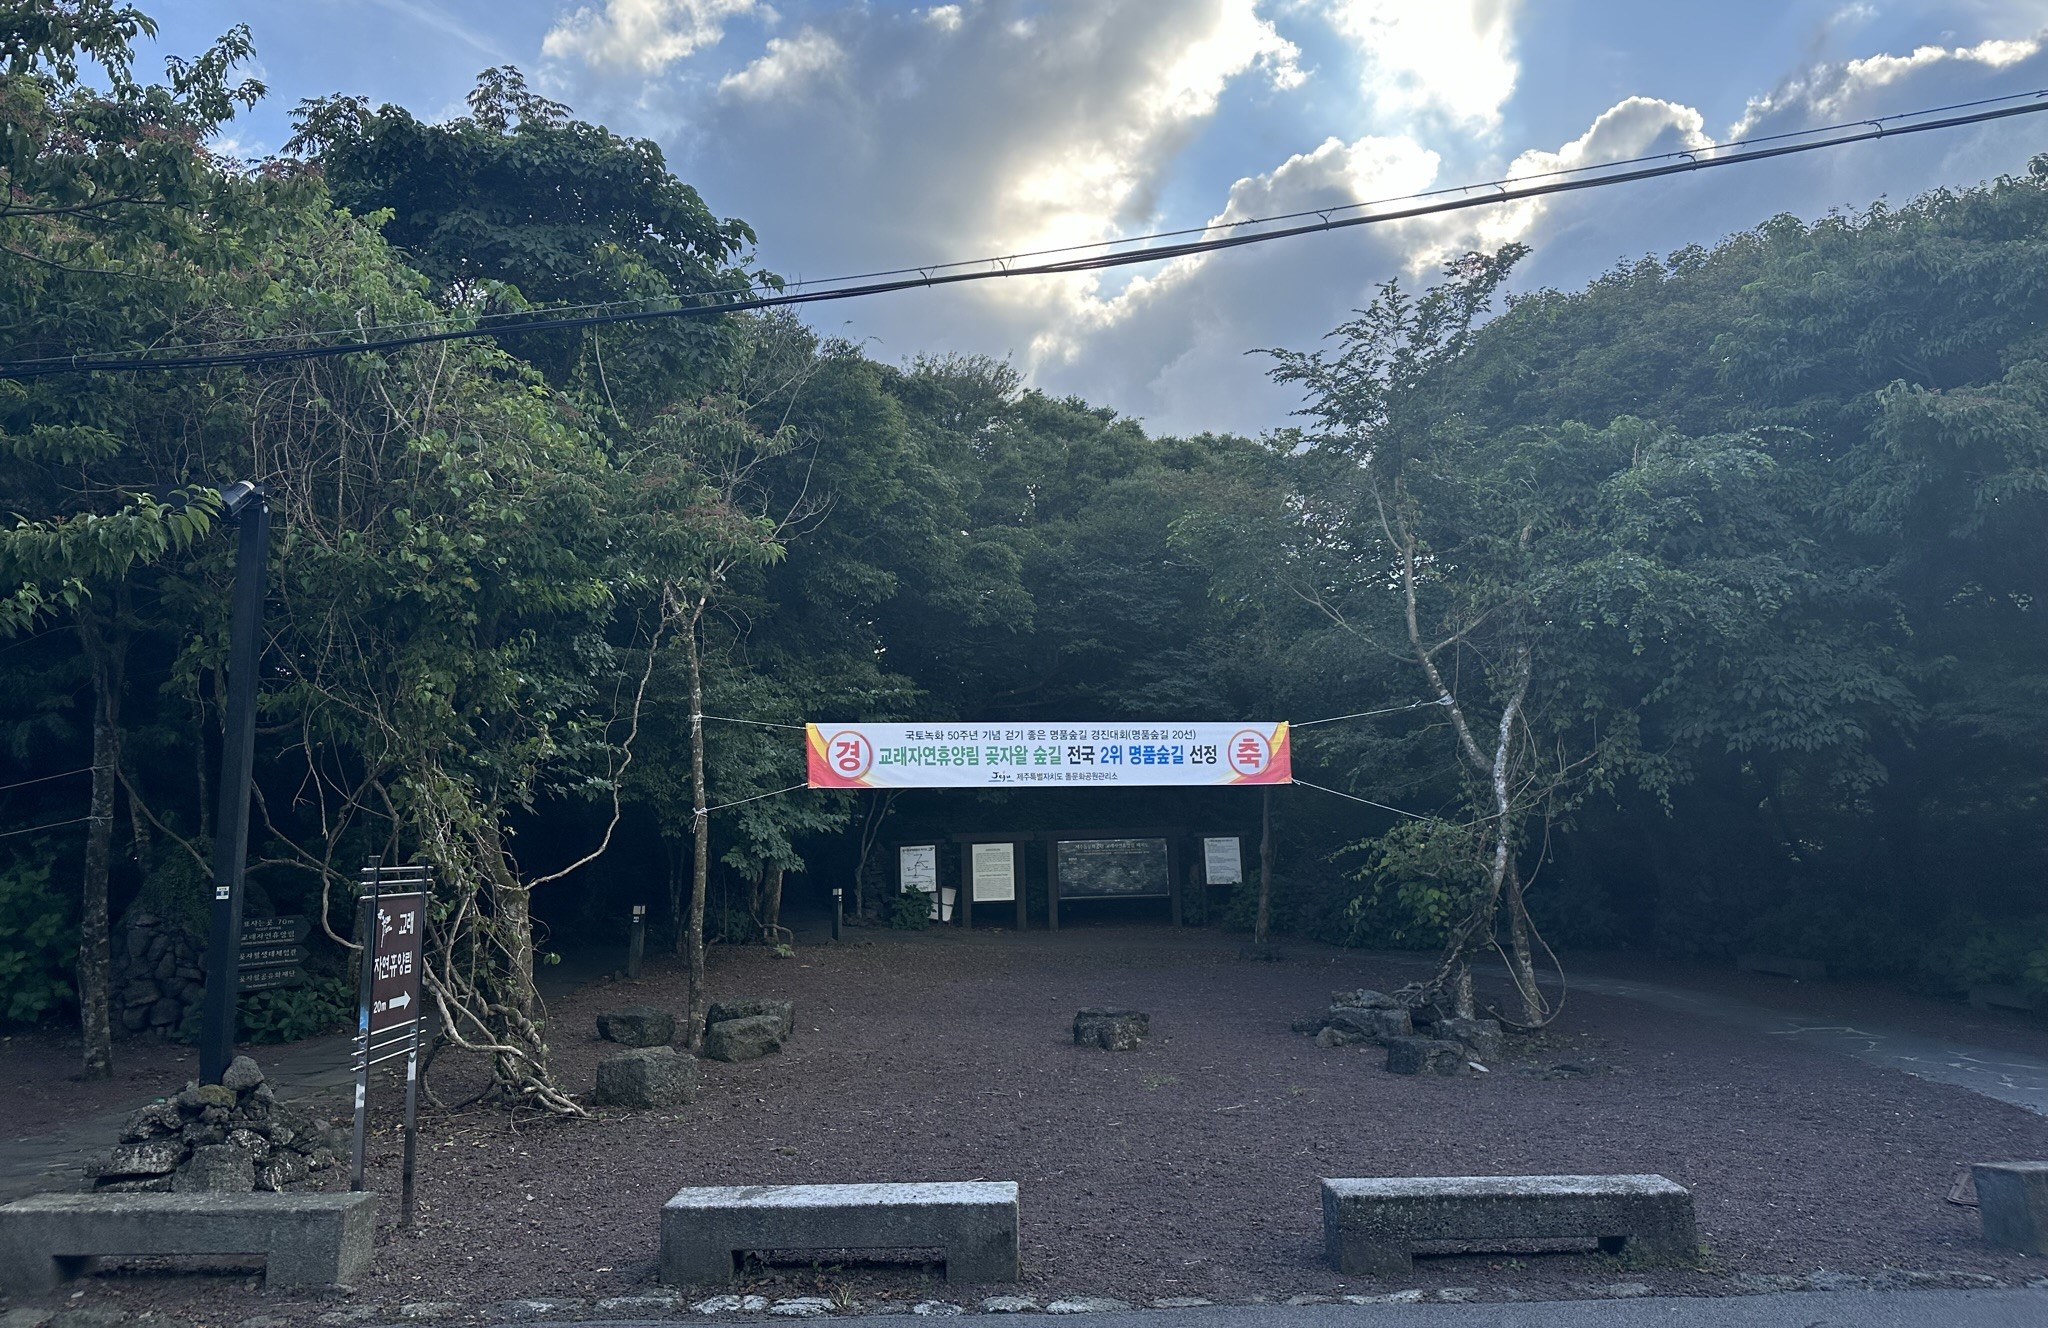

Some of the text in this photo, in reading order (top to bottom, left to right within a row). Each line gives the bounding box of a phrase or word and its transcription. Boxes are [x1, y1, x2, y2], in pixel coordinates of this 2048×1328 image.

[905, 730, 944, 741] 국토녹화
[947, 730, 979, 741] 50주년
[982, 730, 1001, 741] 기념
[1005, 730, 1024, 741] 걷기
[1027, 730, 1046, 741] 좋은
[1050, 729, 1088, 741] 명품숲길
[1172, 729, 1197, 740] 20선)
[836, 740, 861, 771] 경
[878, 744, 1218, 767] 교래자연휴양림 곶자왈 숲길 전국 2위 명품숲길 선정
[1236, 738, 1262, 768] 축
[1016, 772, 1118, 781] 제주특별자치도 돌문화공원관리소
[277, 918, 295, 926] 70m
[398, 910, 415, 935] 교래
[374, 950, 413, 981] 자연휴양림
[373, 1000, 387, 1014] 20m
